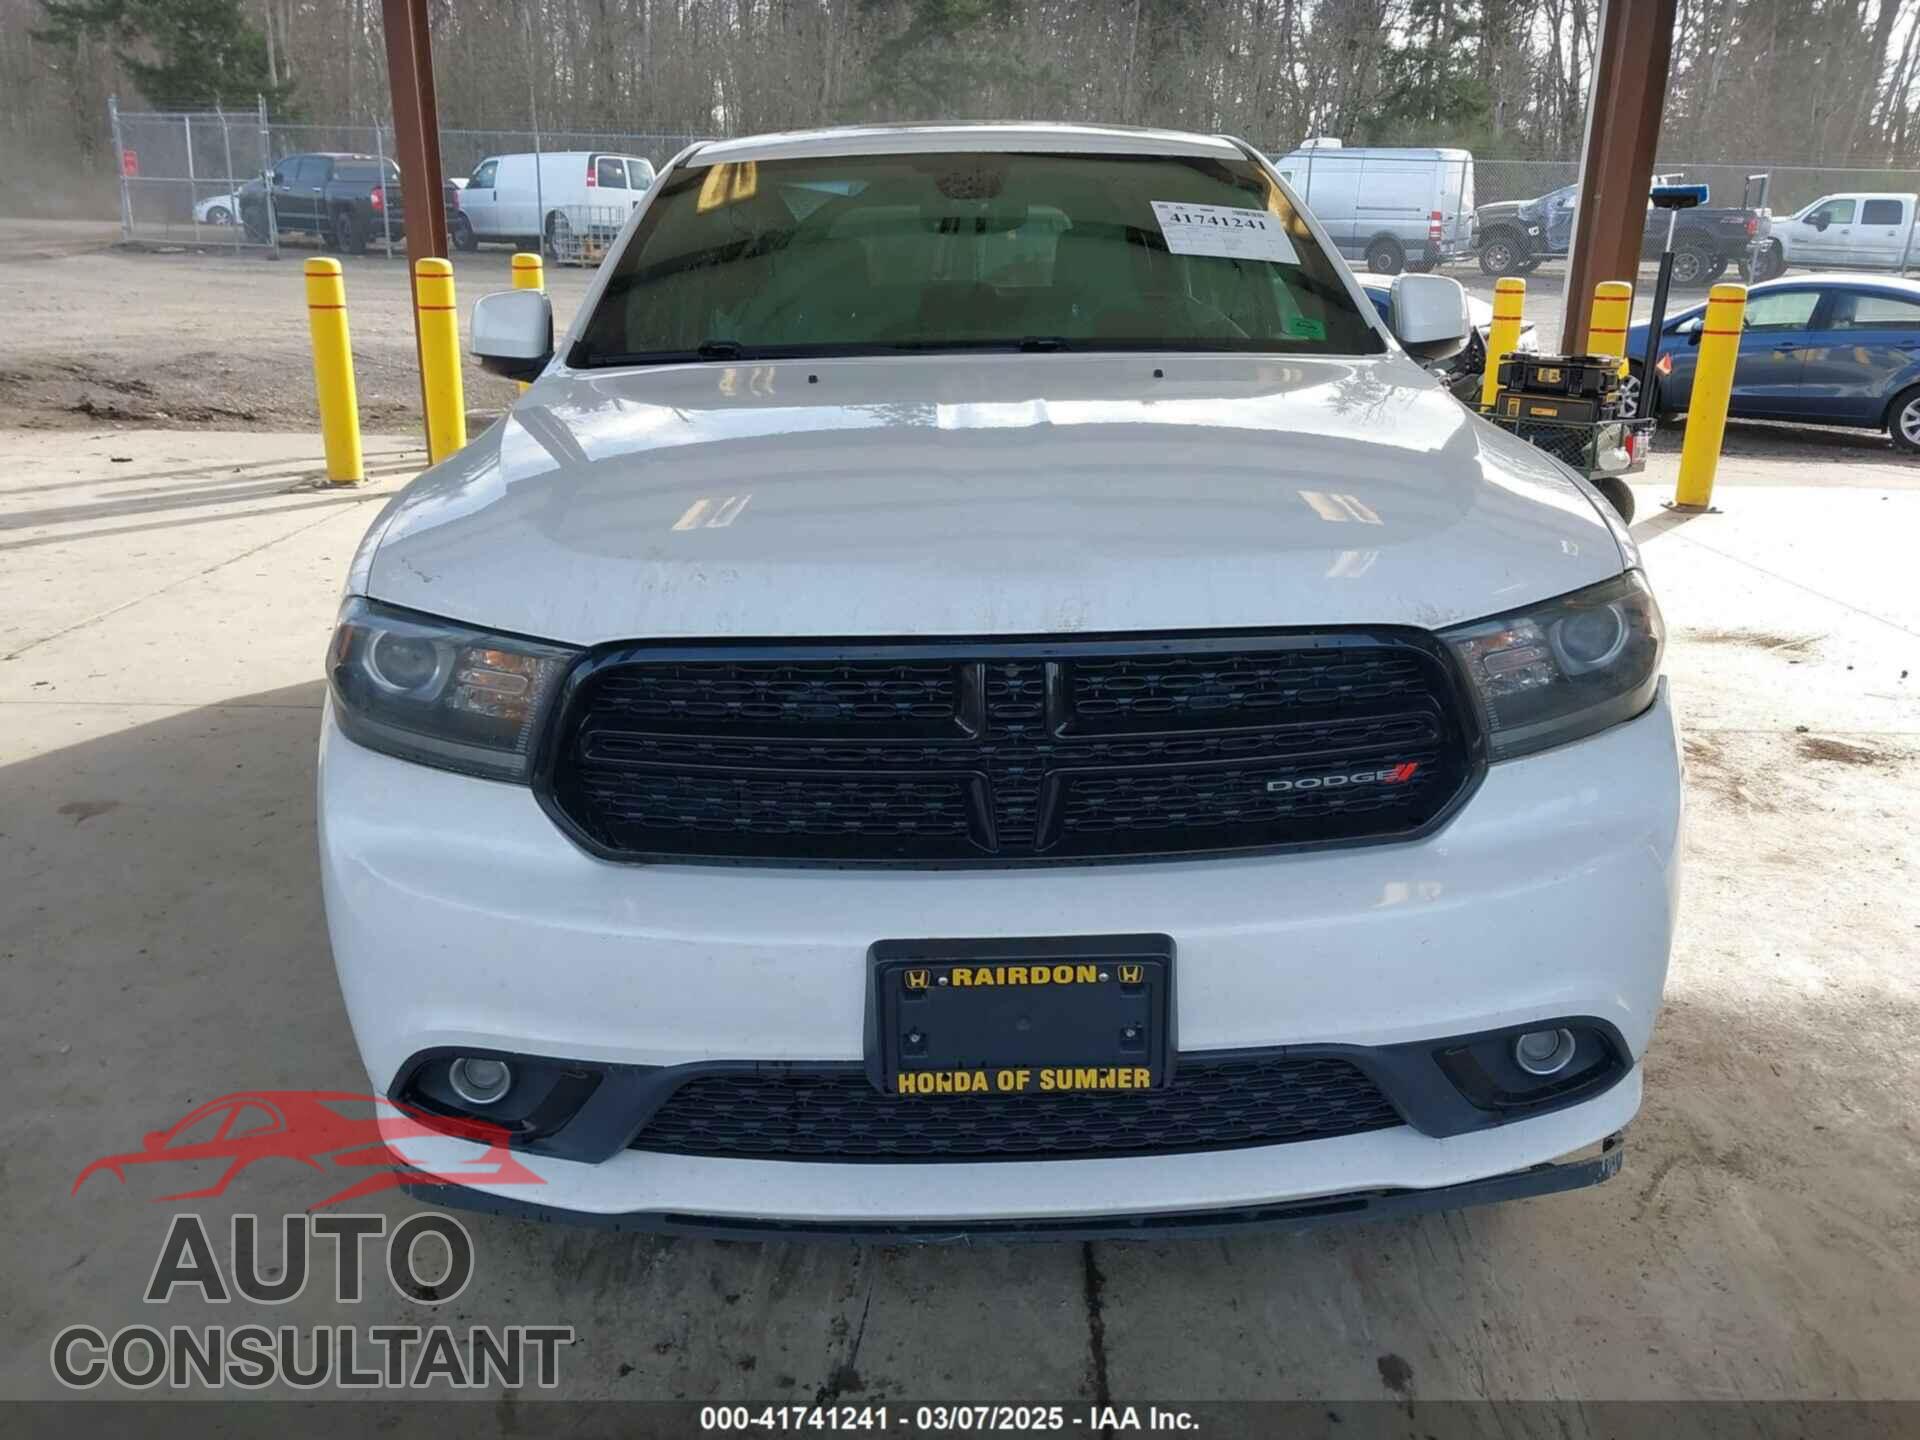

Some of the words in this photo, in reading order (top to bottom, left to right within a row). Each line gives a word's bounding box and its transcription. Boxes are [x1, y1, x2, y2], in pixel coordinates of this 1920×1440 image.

[1169, 213, 1266, 230] 41741241
[1267, 769, 1402, 791] DODGE
[952, 965, 1097, 986] RAIRDON
[898, 1072, 989, 1094] HONDA
[997, 1070, 1031, 1091] OF
[1040, 1068, 1151, 1091] SUMNER
